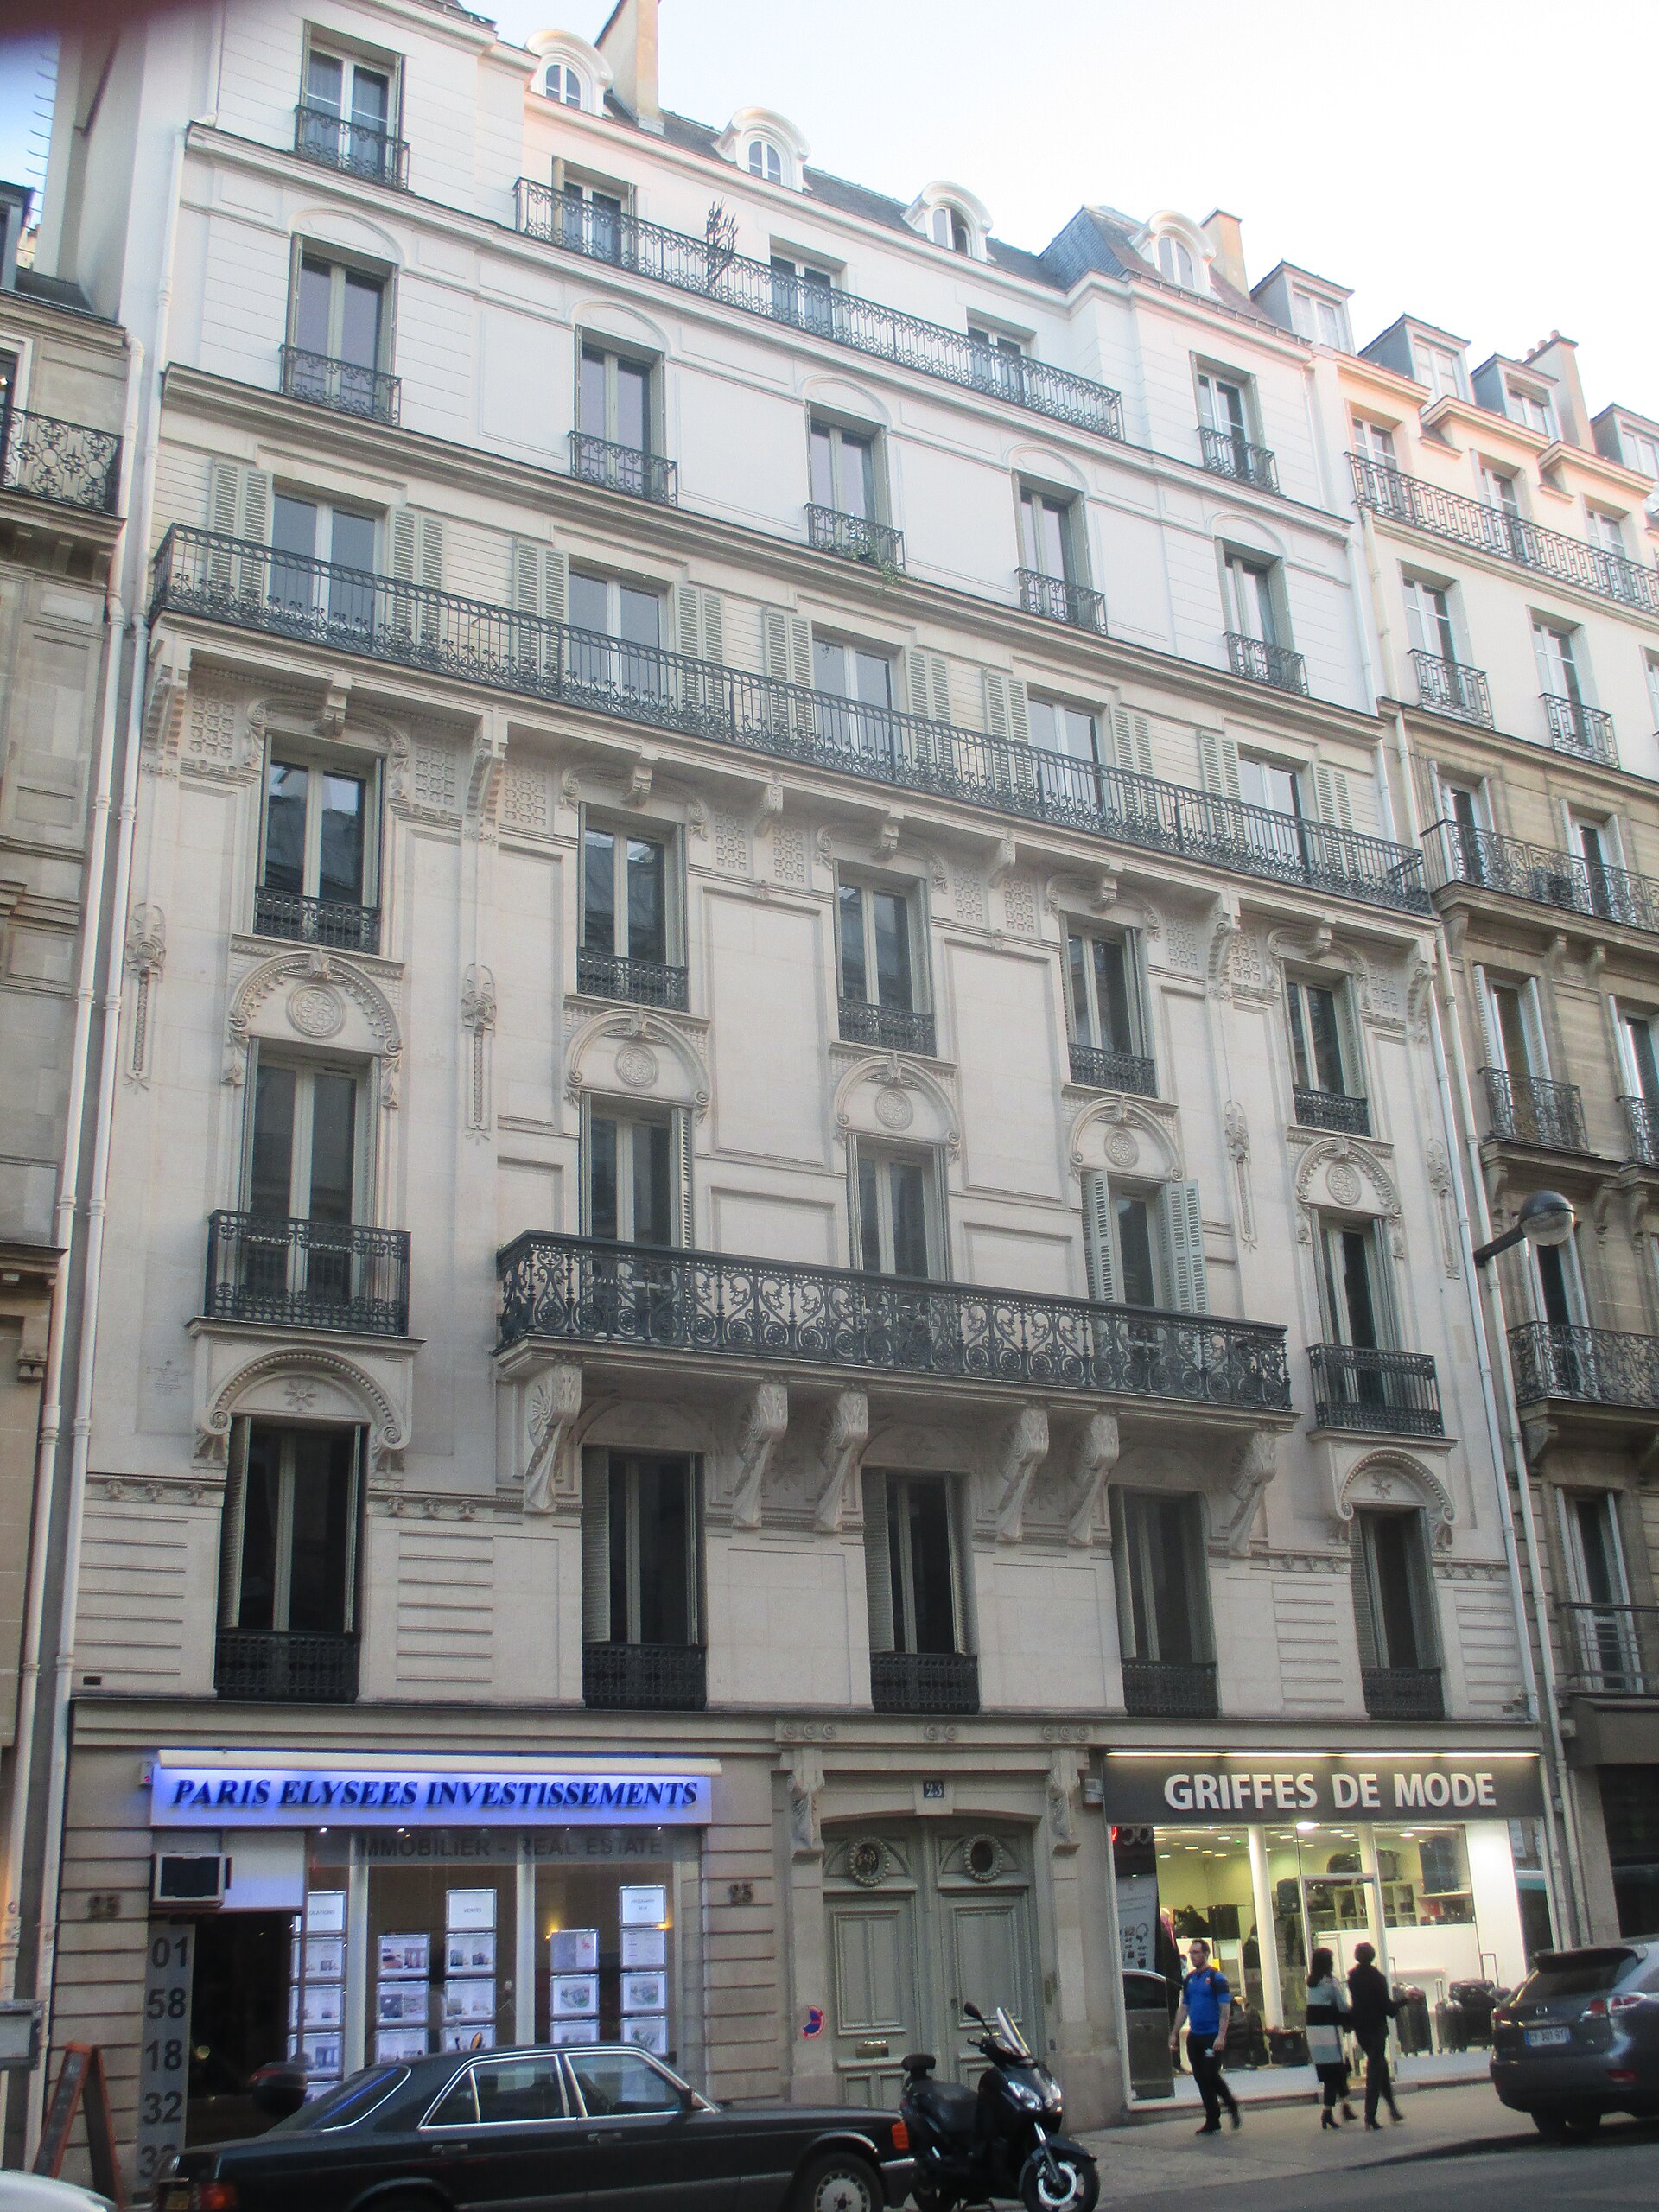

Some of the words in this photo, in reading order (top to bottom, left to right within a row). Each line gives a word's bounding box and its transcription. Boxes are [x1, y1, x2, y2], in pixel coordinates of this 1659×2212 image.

[173, 1779, 271, 1804] PARIS
[278, 1780, 418, 1804] ELYSEES
[425, 1781, 697, 1805] INVESTISSEMENTS
[926, 1783, 943, 1796] 23
[1164, 1773, 1318, 1810] GRIFFES
[1332, 1773, 1381, 1808] DE
[1394, 1772, 1497, 1808] MODE
[586, 1837, 663, 1856] ESTATE
[151, 1936, 188, 1969] 01
[147, 1987, 187, 2020] 58
[145, 2039, 182, 2071] 18
[143, 2091, 182, 2125] 32
